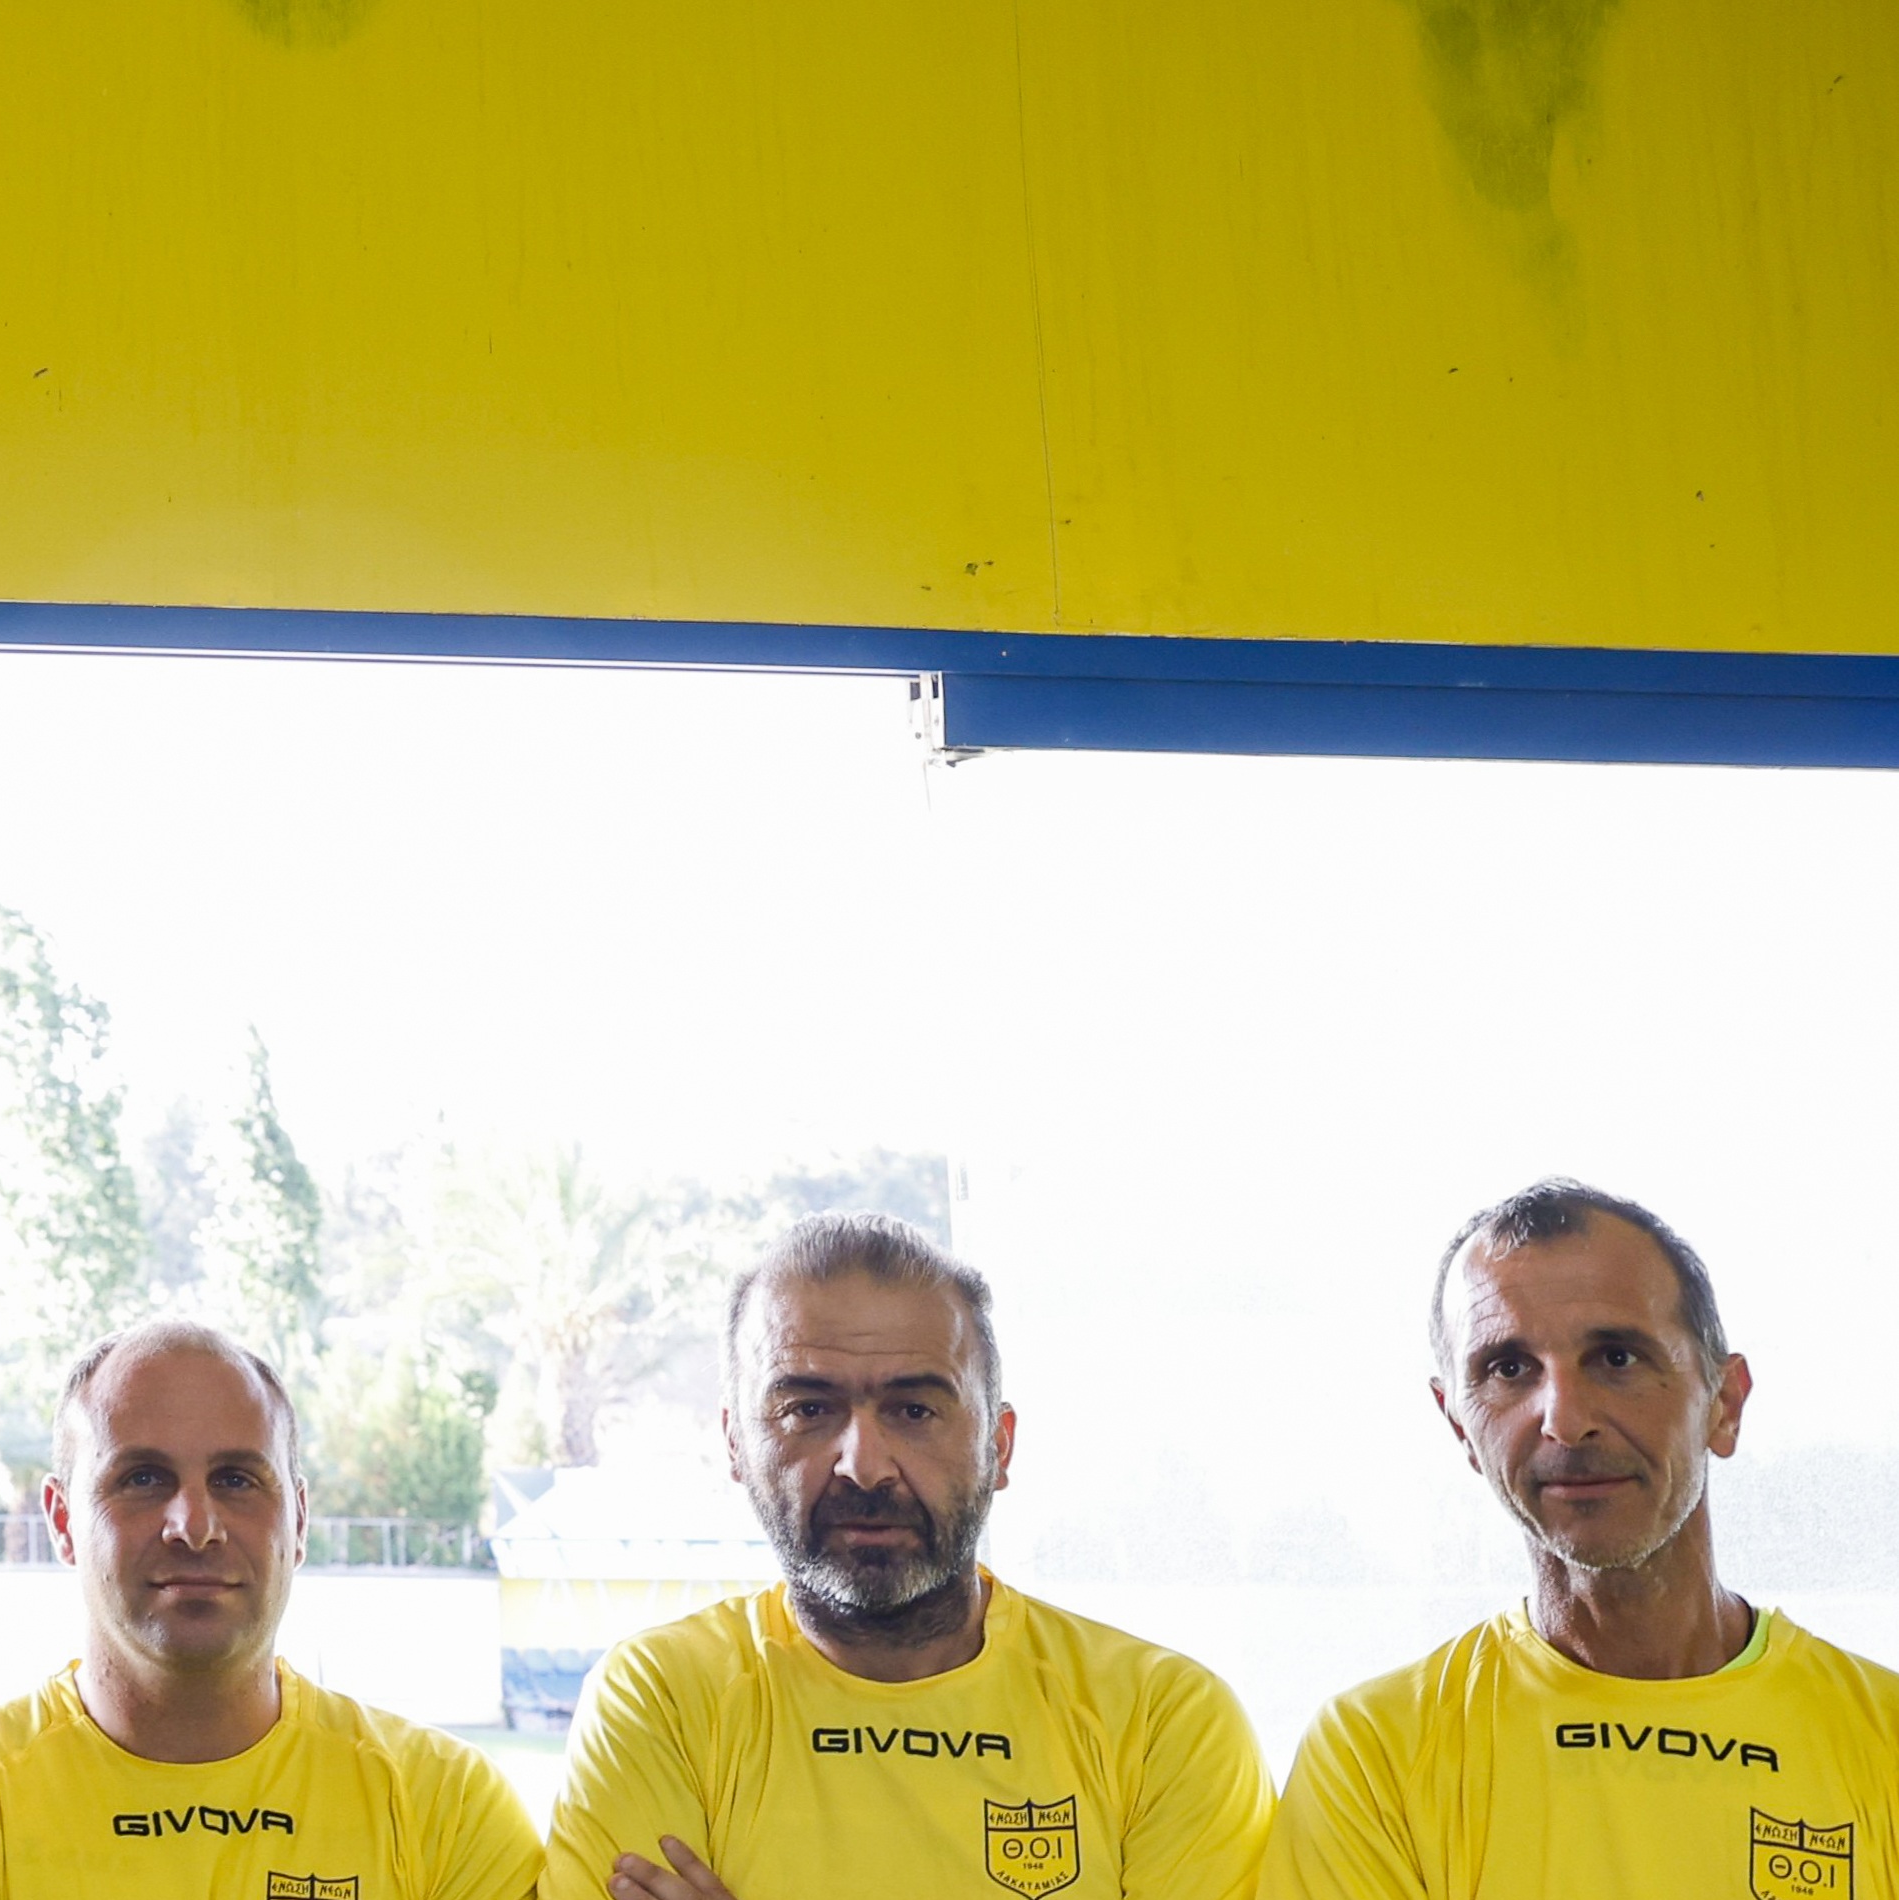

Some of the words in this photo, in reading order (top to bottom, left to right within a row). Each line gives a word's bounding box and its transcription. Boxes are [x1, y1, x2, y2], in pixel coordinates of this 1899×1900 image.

[812, 1726, 1012, 1760] GIVOVA
[1555, 1722, 1779, 1772] GIVOVA
[112, 1805, 294, 1837] GIVOVA
